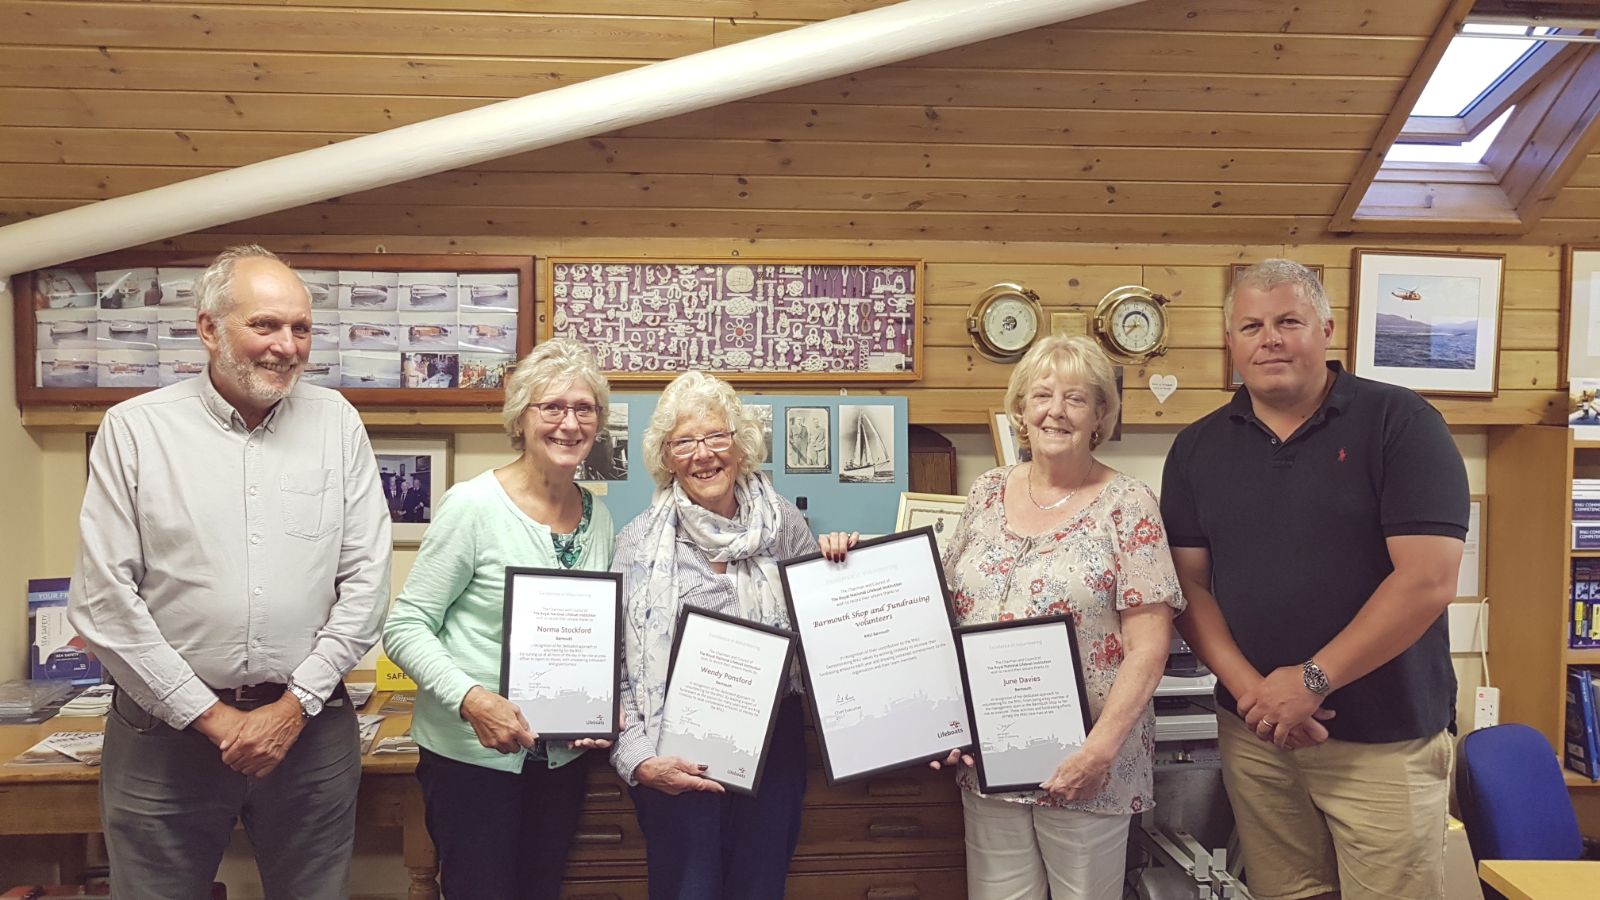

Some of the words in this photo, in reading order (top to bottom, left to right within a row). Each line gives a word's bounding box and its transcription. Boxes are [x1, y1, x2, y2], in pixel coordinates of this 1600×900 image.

[813, 613, 850, 628] Barmouth
[852, 610, 868, 619] Shop
[870, 604, 887, 614] and
[884, 595, 930, 612] Fundraising
[855, 614, 893, 627] volunteers
[701, 666, 723, 679] Wendy
[724, 672, 752, 686] Ponsford
[1003, 679, 1018, 687] June
[1019, 676, 1040, 684] Davies
[937, 728, 964, 738] Lifeboats
